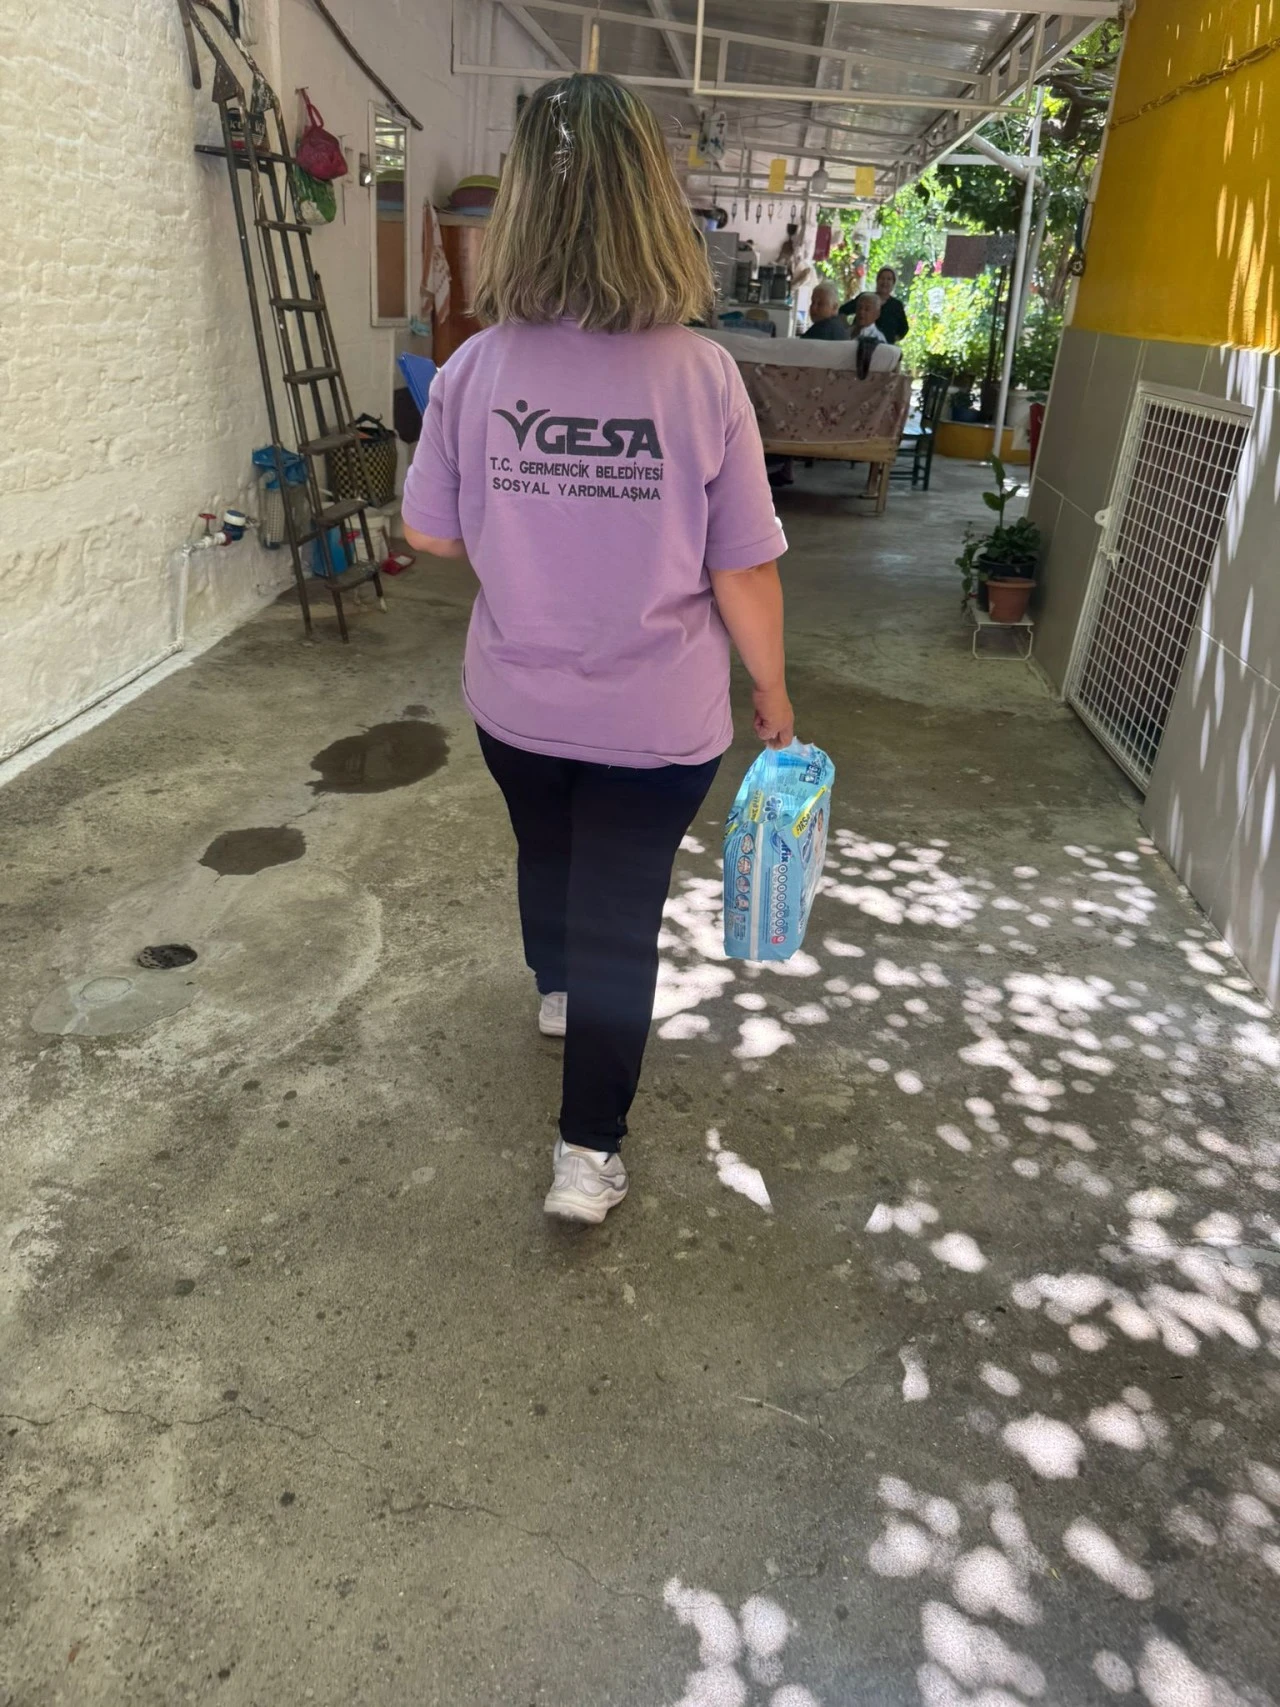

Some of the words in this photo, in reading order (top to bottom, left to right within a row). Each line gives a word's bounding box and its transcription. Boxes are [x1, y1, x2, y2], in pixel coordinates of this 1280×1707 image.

[490, 457, 513, 473] T.C.
[519, 459, 590, 478] GERMENCİK
[595, 461, 664, 481] BELEDİYESİ
[492, 477, 550, 495] SOSYAL
[558, 483, 661, 502] YARDIMLAŞMA
